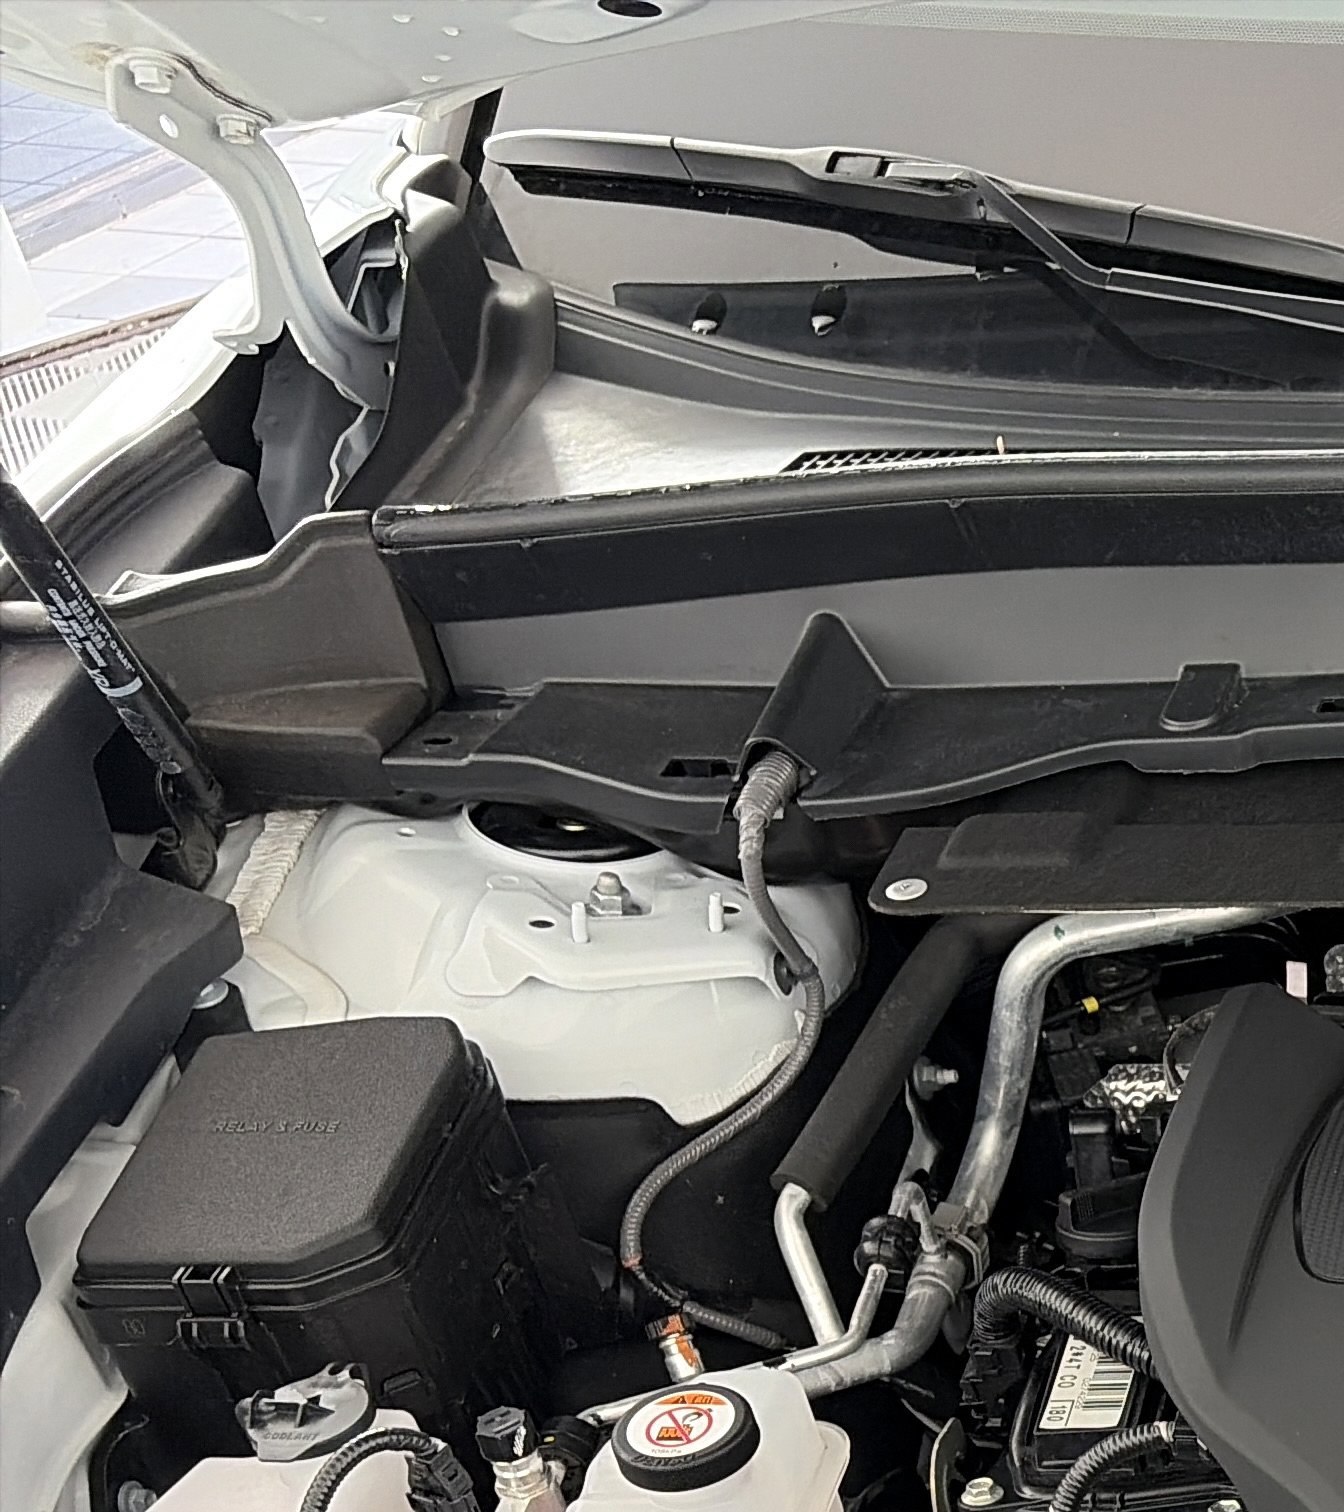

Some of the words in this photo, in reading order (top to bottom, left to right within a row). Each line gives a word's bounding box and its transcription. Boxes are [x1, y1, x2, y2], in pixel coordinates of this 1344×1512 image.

[214, 1120, 274, 1133] RELAY
[293, 1120, 341, 1133] FUSE
[263, 1431, 320, 1441] COOLANT
